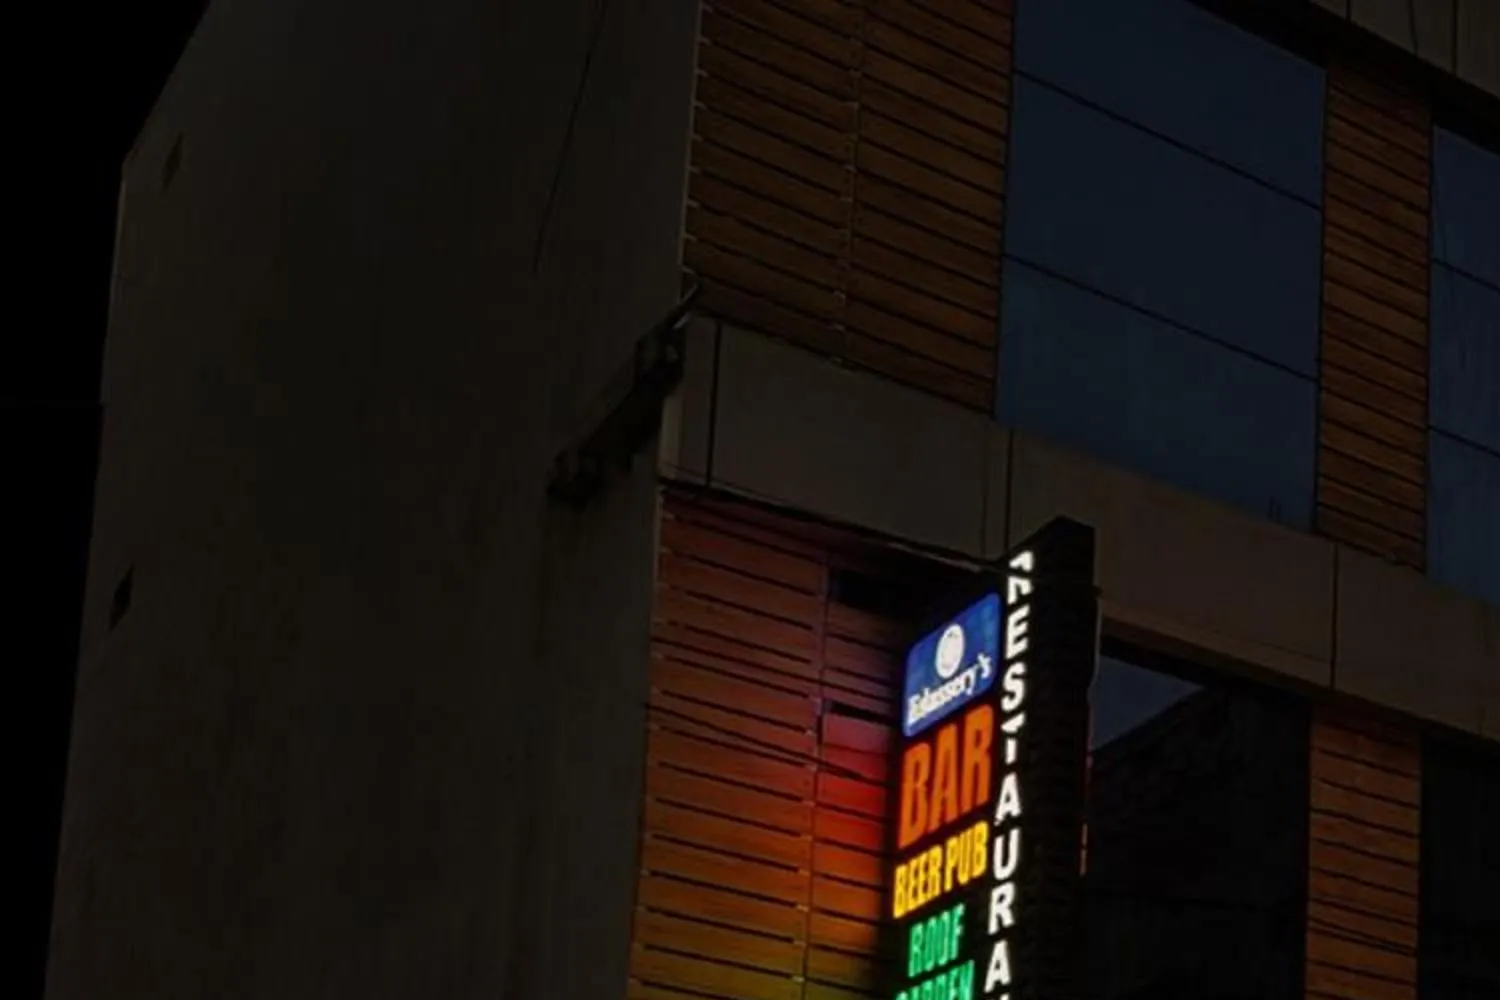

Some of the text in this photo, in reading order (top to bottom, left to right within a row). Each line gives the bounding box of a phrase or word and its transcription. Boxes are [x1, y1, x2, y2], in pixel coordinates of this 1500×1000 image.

[899, 703, 994, 850] BAR
[893, 820, 988, 919] BEER PUB
[908, 903, 965, 978] ROOF
